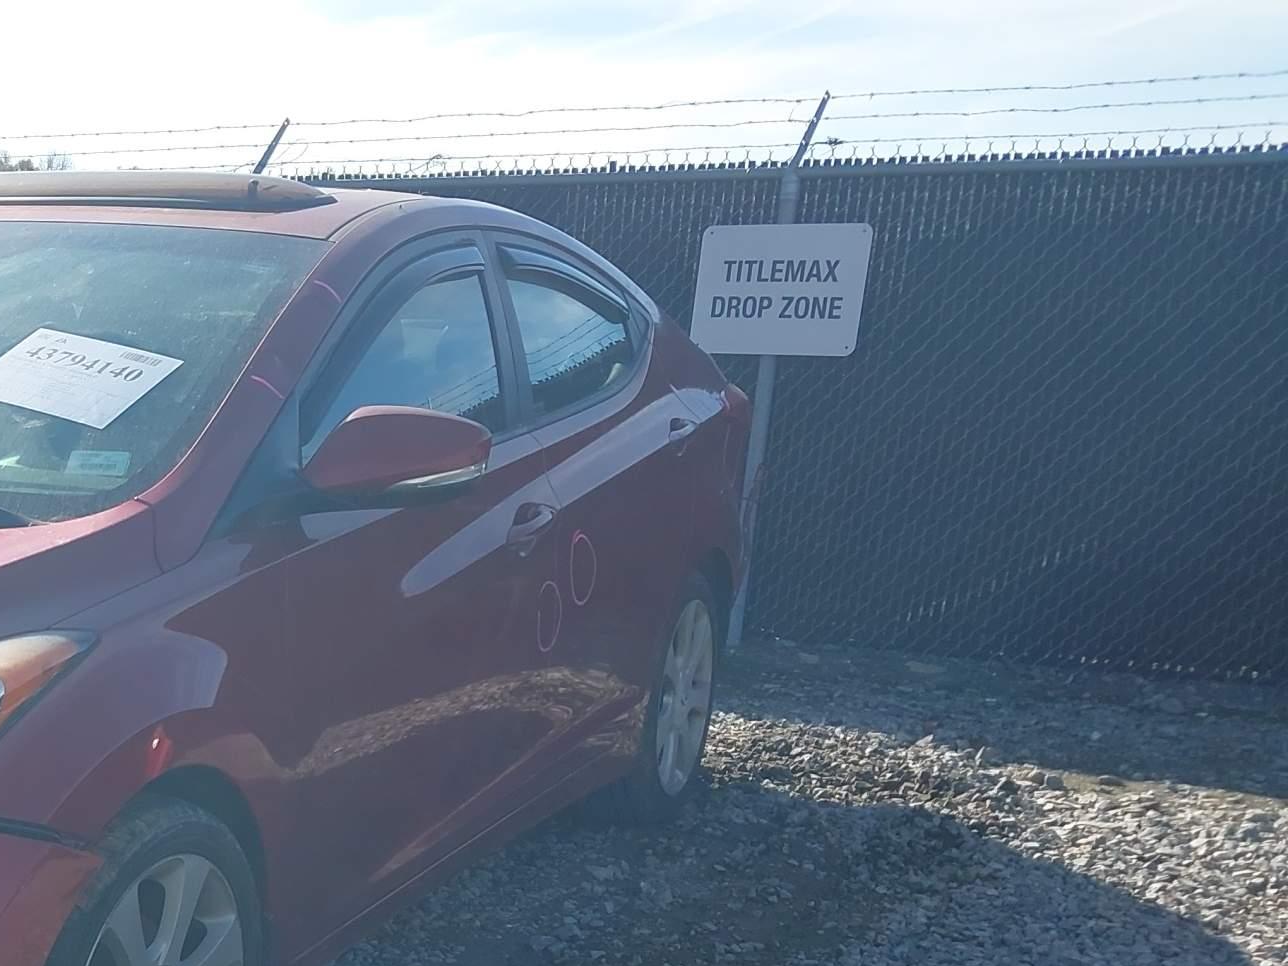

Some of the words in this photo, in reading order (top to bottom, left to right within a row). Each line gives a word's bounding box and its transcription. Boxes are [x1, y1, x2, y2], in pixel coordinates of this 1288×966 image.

[723, 259, 840, 283] TITLEMAX
[710, 295, 773, 319] DROP
[778, 296, 844, 320] ZONE
[26, 346, 144, 382] 43794140
